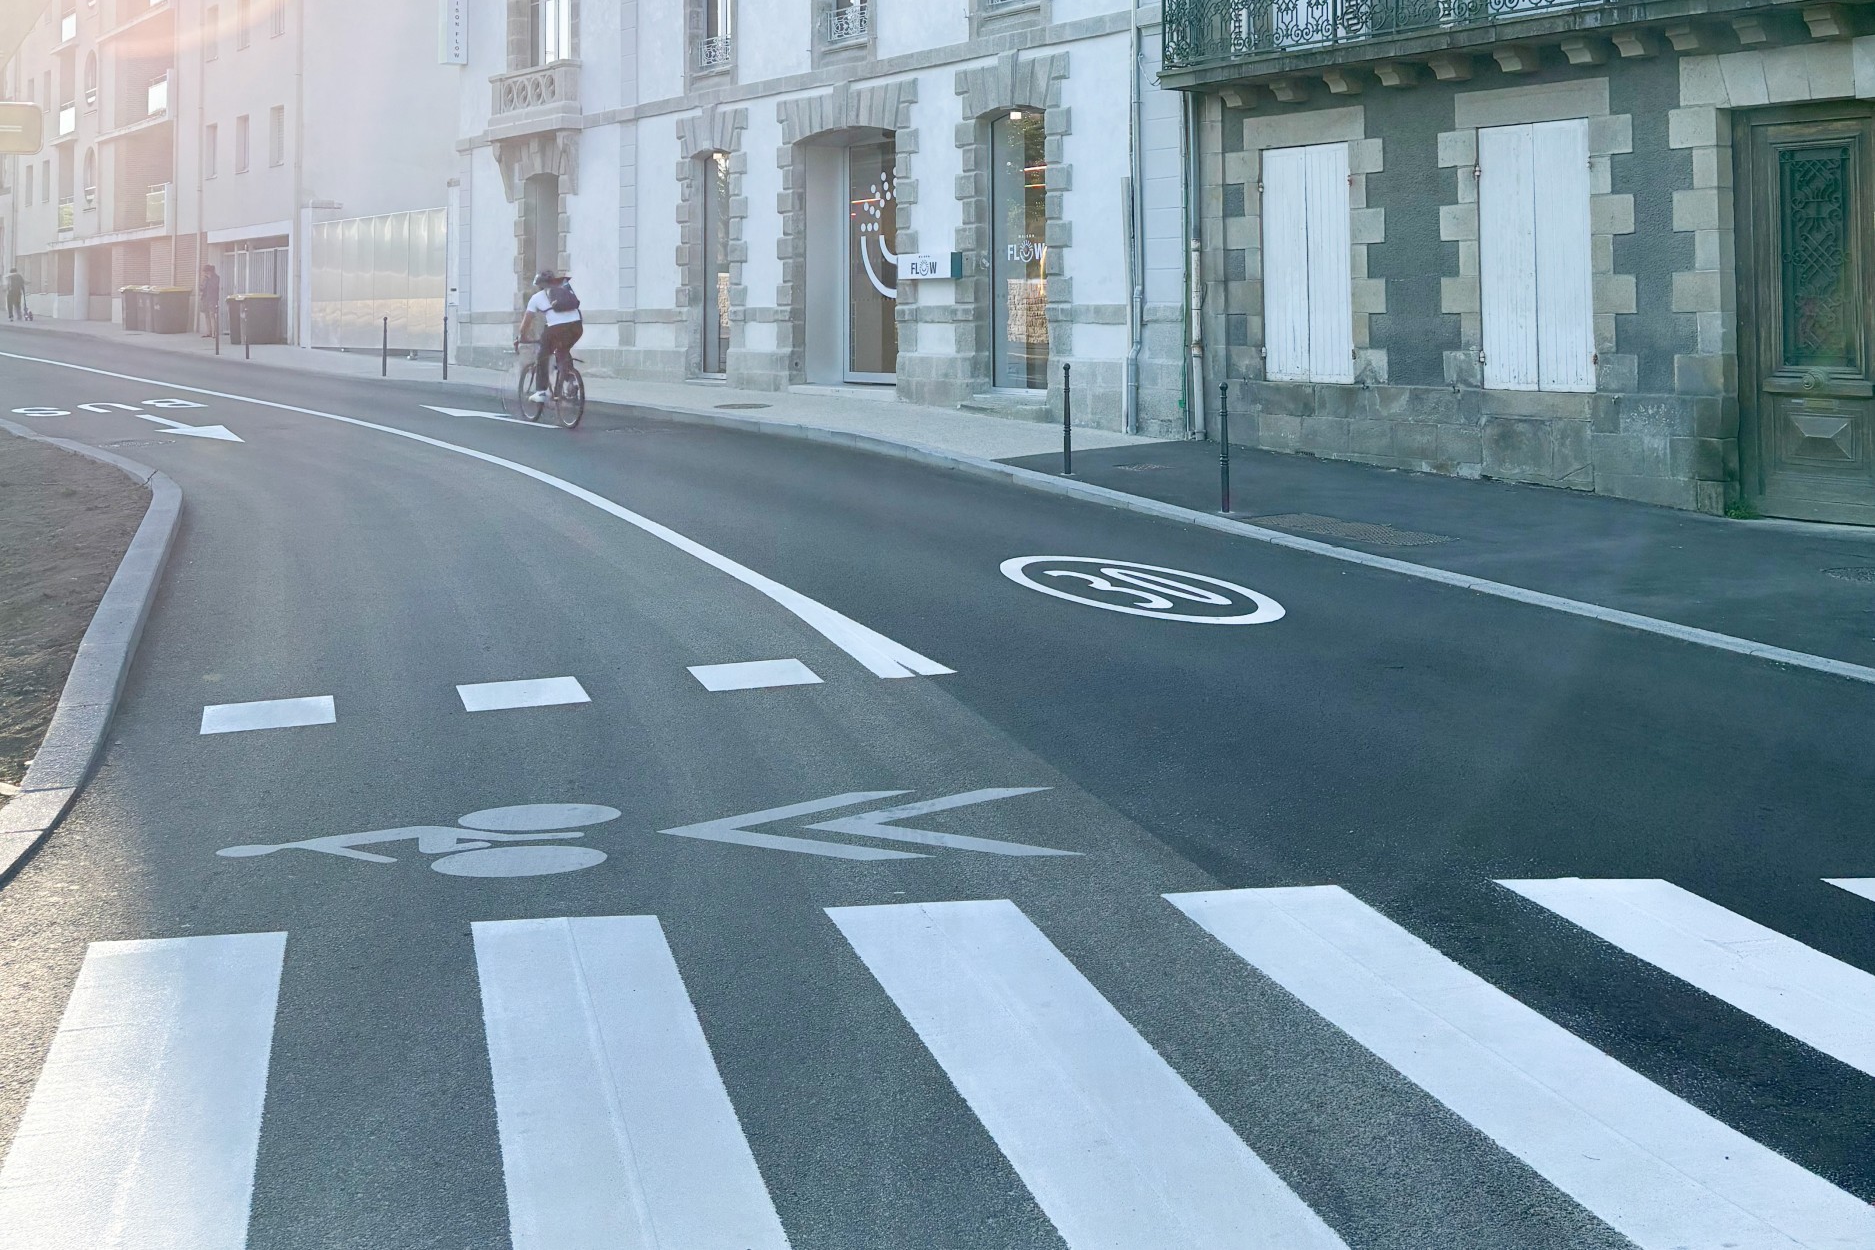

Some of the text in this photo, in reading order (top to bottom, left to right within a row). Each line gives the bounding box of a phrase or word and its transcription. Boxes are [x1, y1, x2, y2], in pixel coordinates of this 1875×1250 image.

[1007, 240, 1045, 263] FLOW
[911, 260, 937, 276] FLOW
[11, 398, 209, 418] BUS
[1042, 567, 1233, 609] 30
